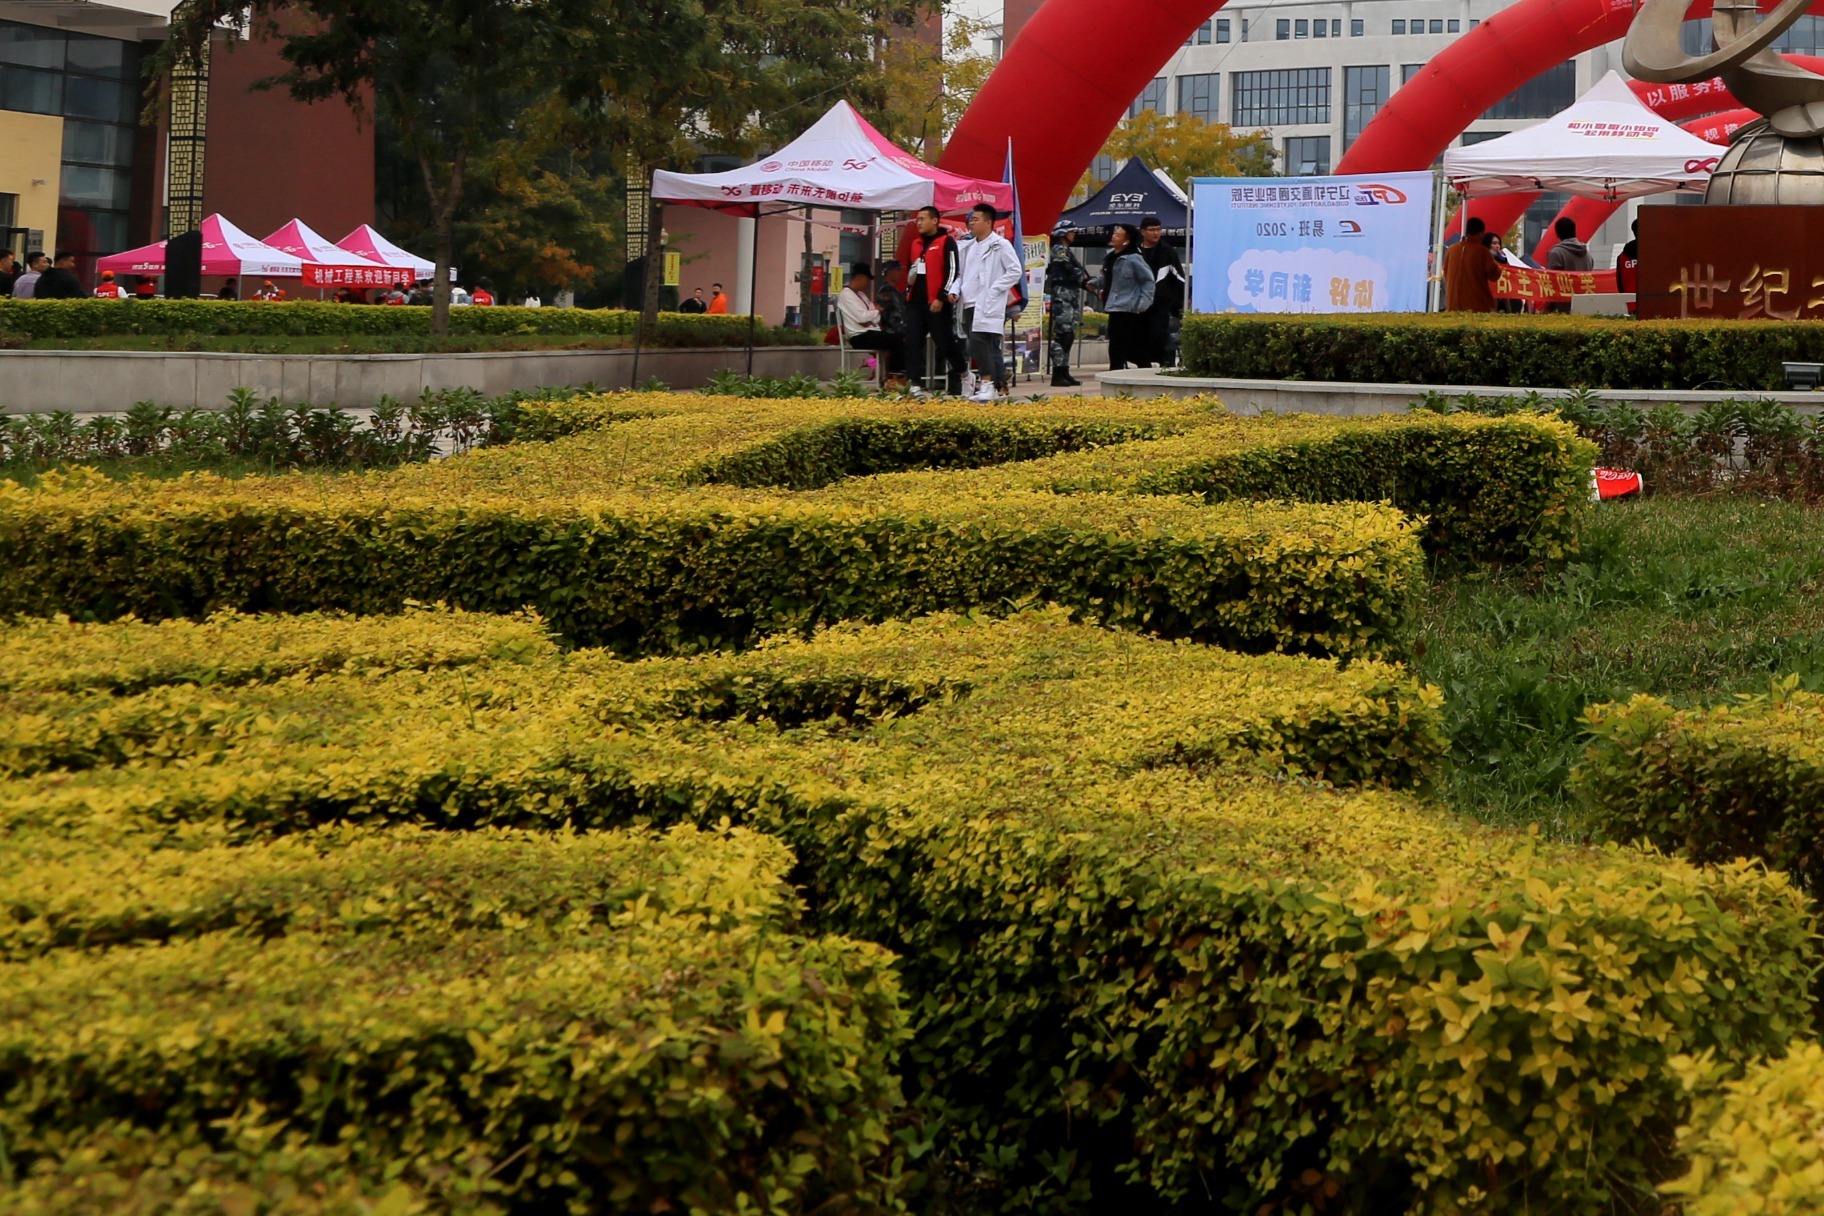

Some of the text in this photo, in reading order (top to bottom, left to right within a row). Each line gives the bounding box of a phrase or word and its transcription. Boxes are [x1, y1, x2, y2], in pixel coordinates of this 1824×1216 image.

[787, 159, 833, 168] 中国移动
[787, 184, 864, 203] 未来无限可能
[314, 268, 410, 286] 机械工程系欢迎新同学
